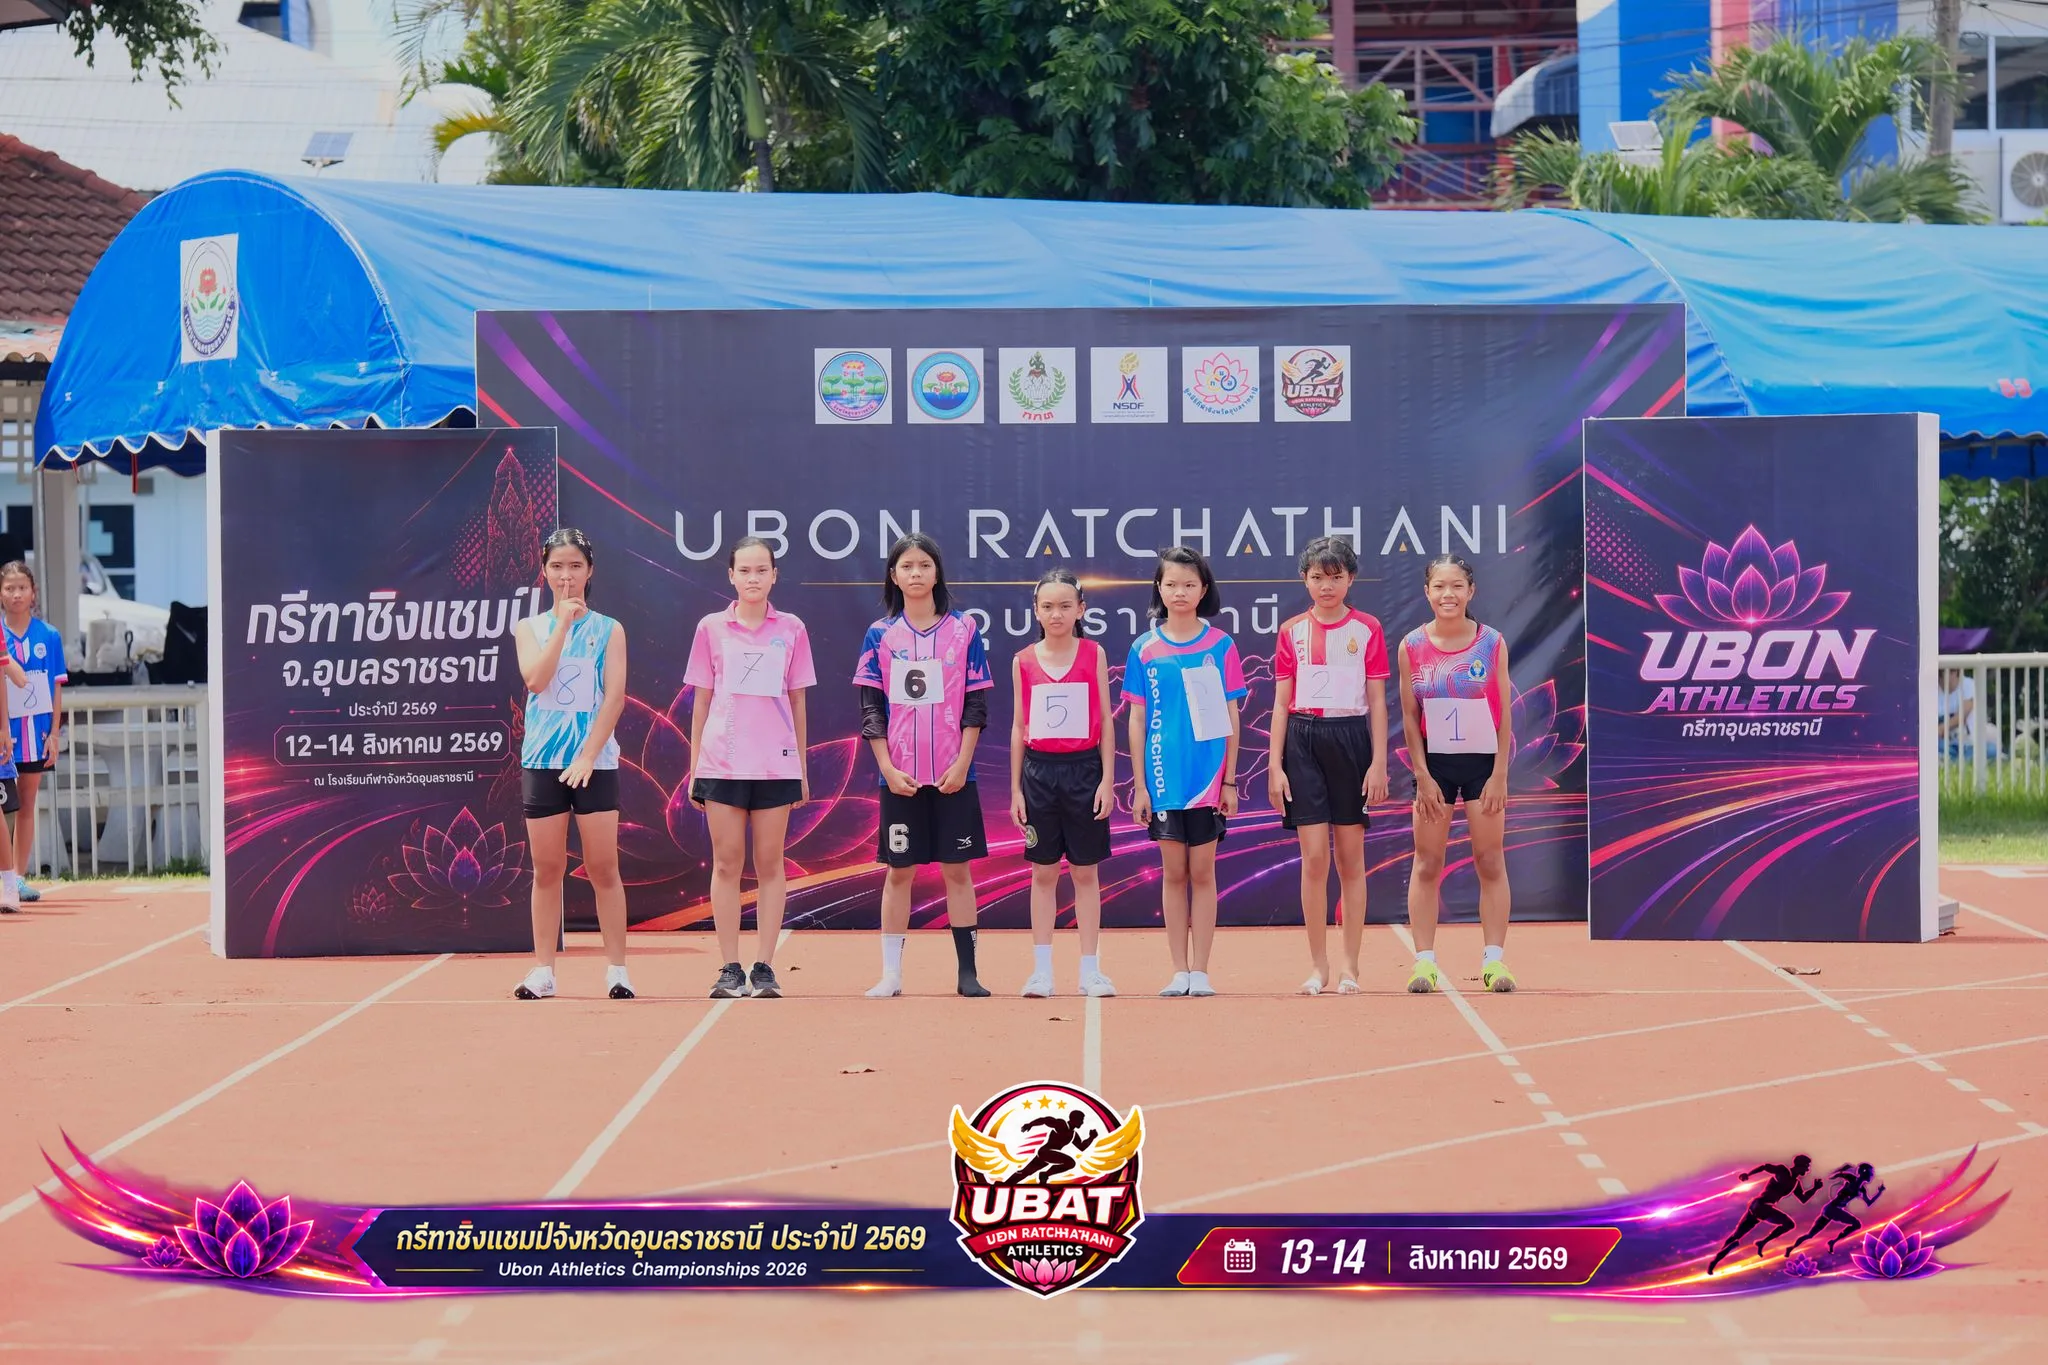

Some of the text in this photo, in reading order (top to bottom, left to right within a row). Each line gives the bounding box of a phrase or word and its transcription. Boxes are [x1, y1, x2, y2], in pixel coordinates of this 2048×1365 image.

[1112, 402, 1144, 410] NSDF
[1287, 384, 1339, 398] UBAT
[675, 504, 1507, 561] UBON RATCHATHANI
[246, 587, 541, 645] กรีฑาชิงแชมป์
[740, 652, 764, 685] 7
[1639, 629, 1878, 681] UBON
[281, 645, 499, 697] จ.อุบลราชธานี
[556, 664, 581, 705] 8
[904, 669, 927, 699] 6
[1311, 670, 1333, 699] 2
[348, 701, 438, 717] ประจำปี 2569
[1046, 695, 1069, 729] 5
[1646, 684, 1868, 714] ATHLETICS
[1445, 707, 1466, 741] 1
[1682, 717, 1823, 741] กรีฑาอุบลราชธานี
[285, 731, 503, 757] 12-14 สิงหาคม 2569
[314, 771, 474, 787] ณ โรงเรียนกีฬาจังหวัดอุบลราชธานี
[1151, 733, 1167, 798] SCHOOL
[888, 823, 910, 854] 6
